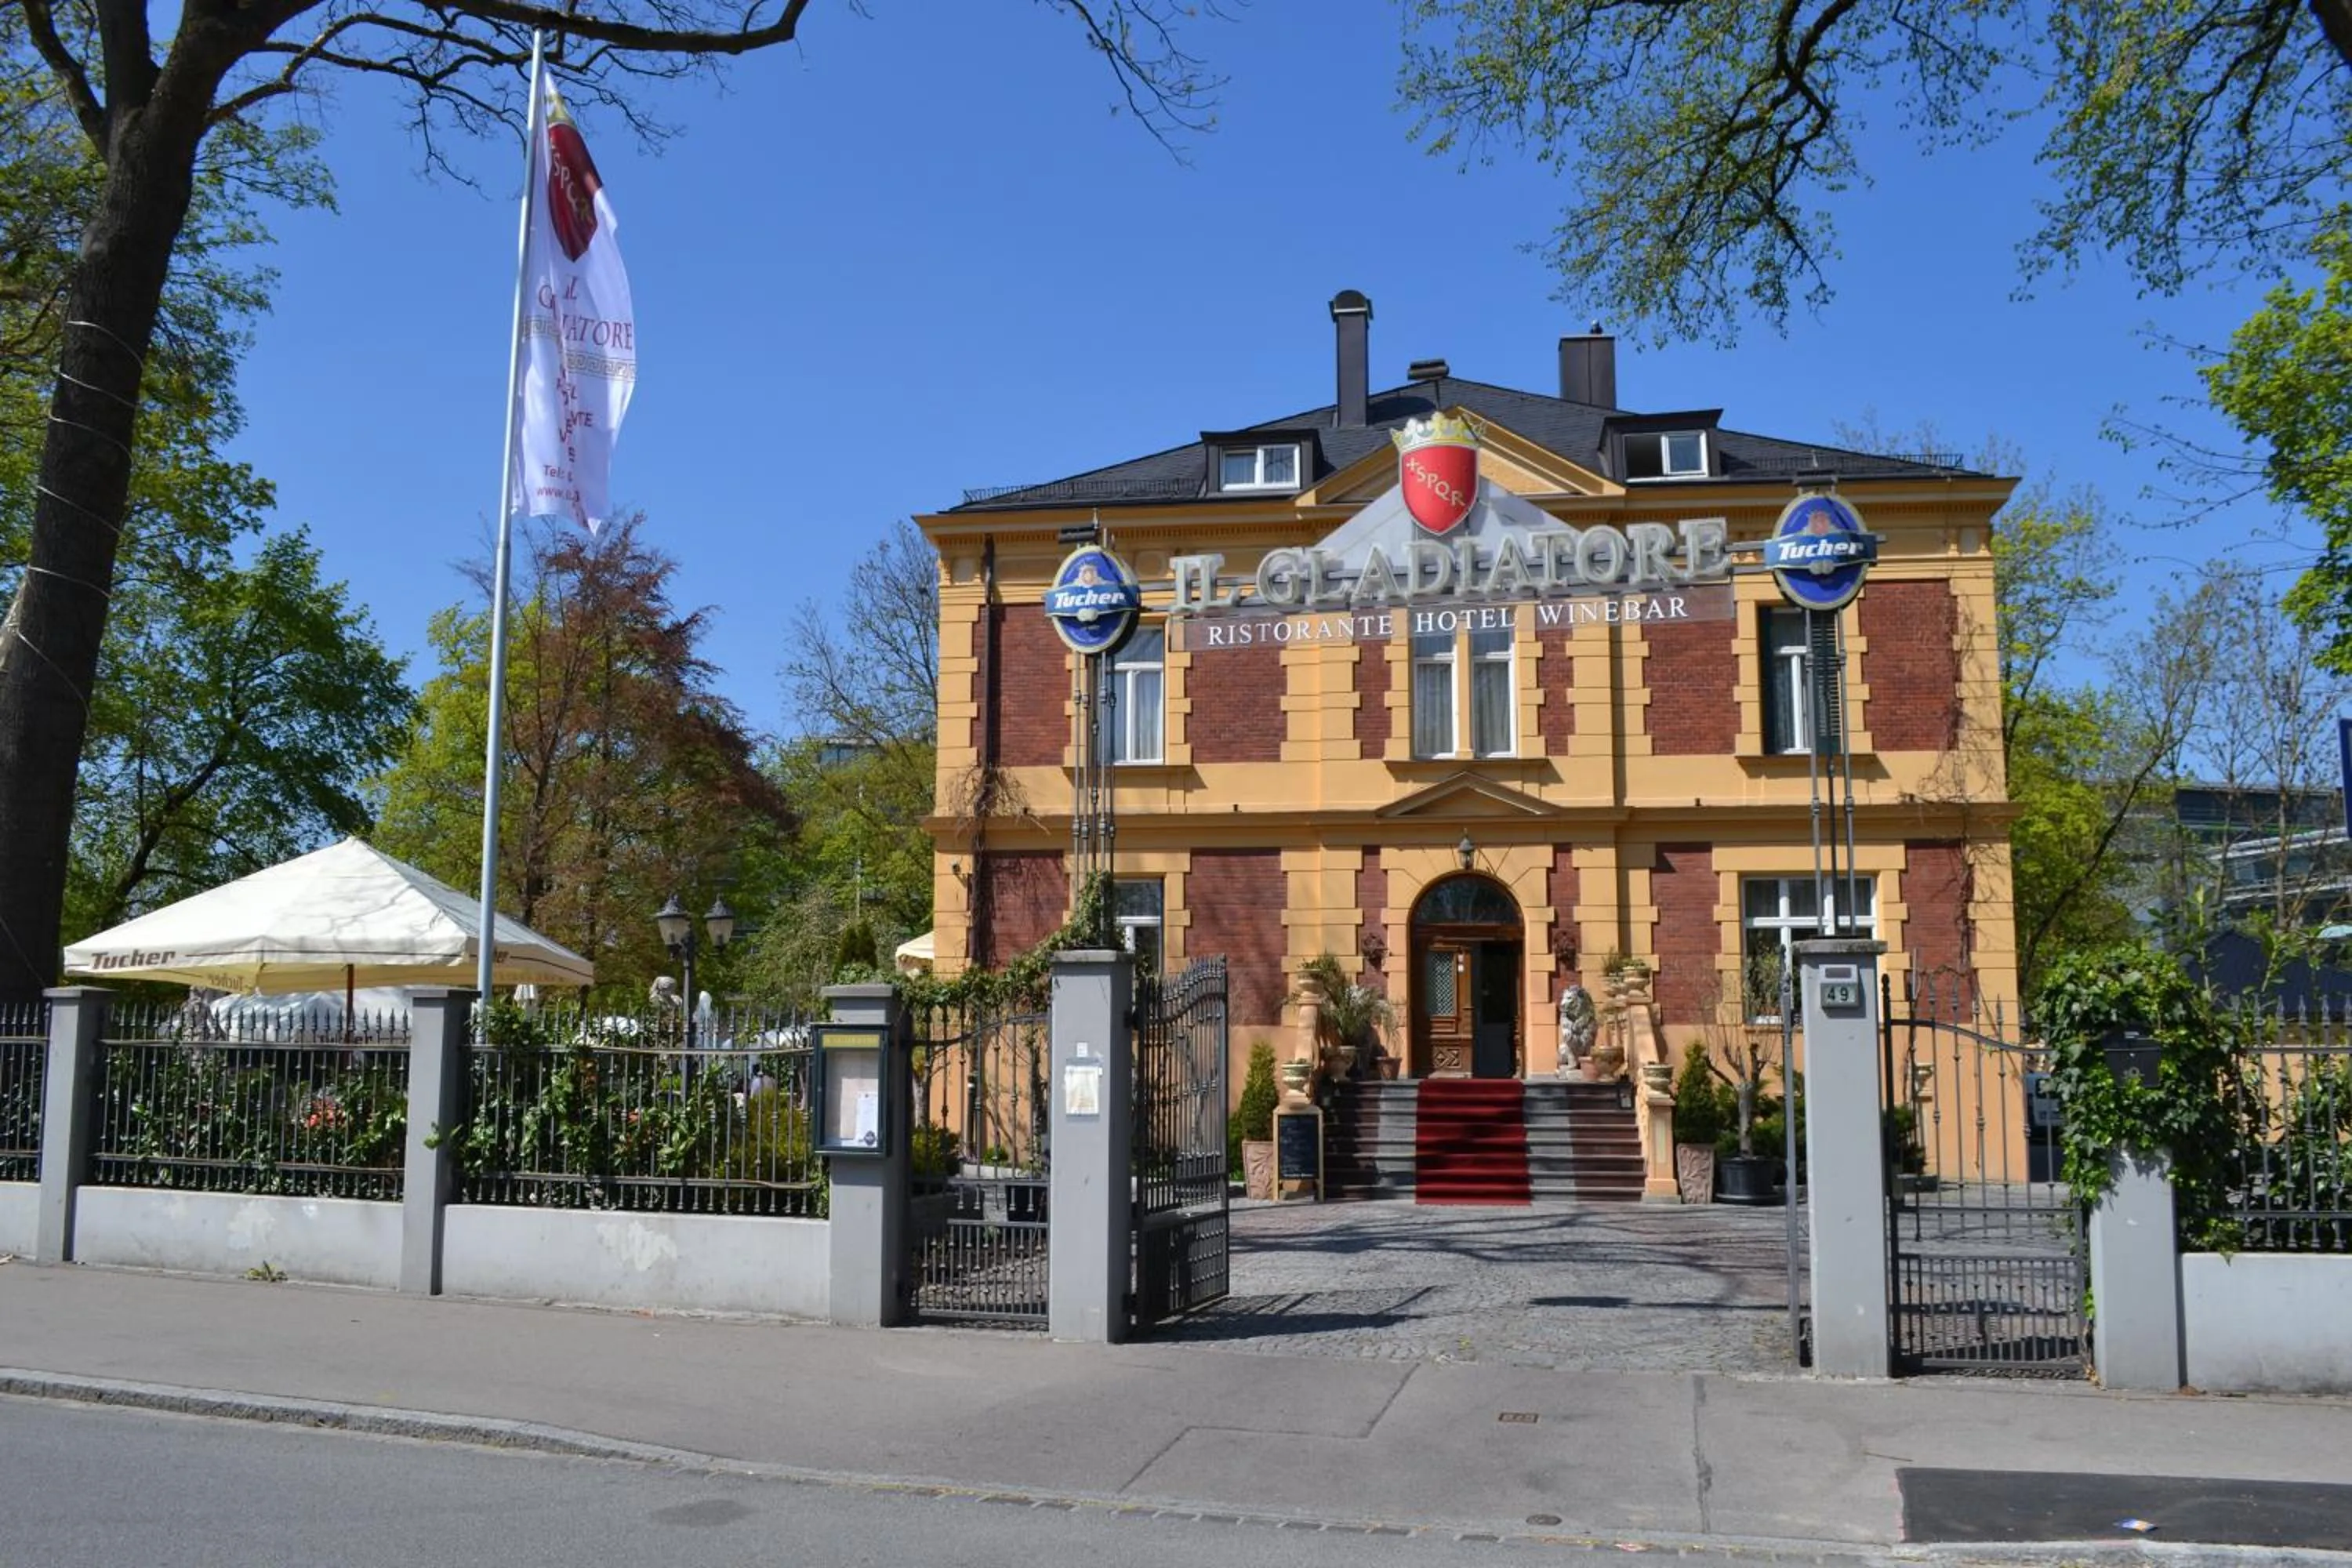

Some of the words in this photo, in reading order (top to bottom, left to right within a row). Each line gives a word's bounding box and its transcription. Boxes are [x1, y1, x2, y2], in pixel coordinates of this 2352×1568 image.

[1778, 539, 1864, 561] Tucher
[1170, 553, 1240, 613] IL
[1256, 517, 1730, 609] GLADIATORE
[1054, 589, 1126, 609] Tucher
[1207, 615, 1394, 646] RISTORANTE
[1415, 607, 1518, 633] HOTEL
[1539, 596, 1690, 626] WINEBAR
[91, 949, 176, 970] Tucher
[1827, 985, 1849, 1001] 49
